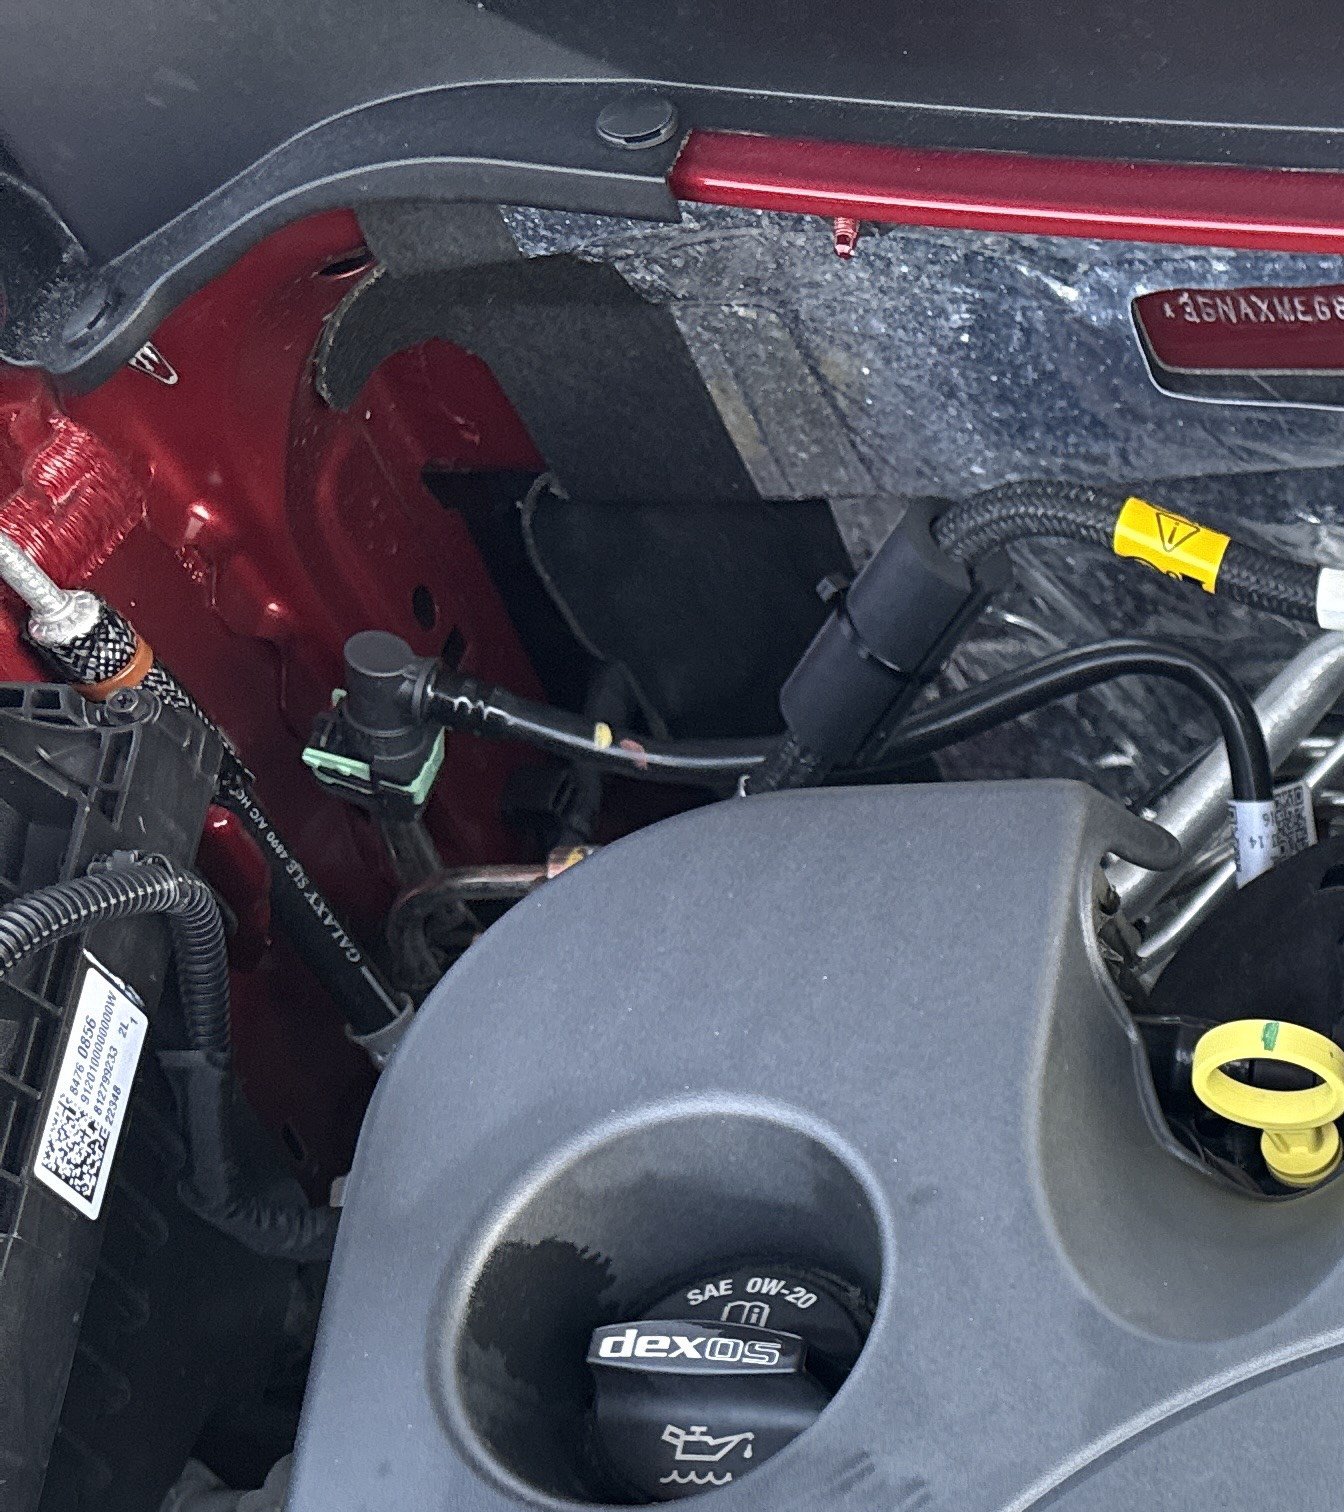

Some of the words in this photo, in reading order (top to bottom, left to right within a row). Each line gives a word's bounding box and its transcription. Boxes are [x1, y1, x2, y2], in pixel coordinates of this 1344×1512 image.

[303, 890, 361, 962] GALAXY
[69, 1062, 85, 1096] 8476
[77, 1014, 97, 1059] 0856
[93, 1045, 118, 1116] 812799233
[686, 1278, 734, 1306] SAE
[745, 1277, 818, 1309] 0W-20
[598, 1328, 782, 1366] dexos
